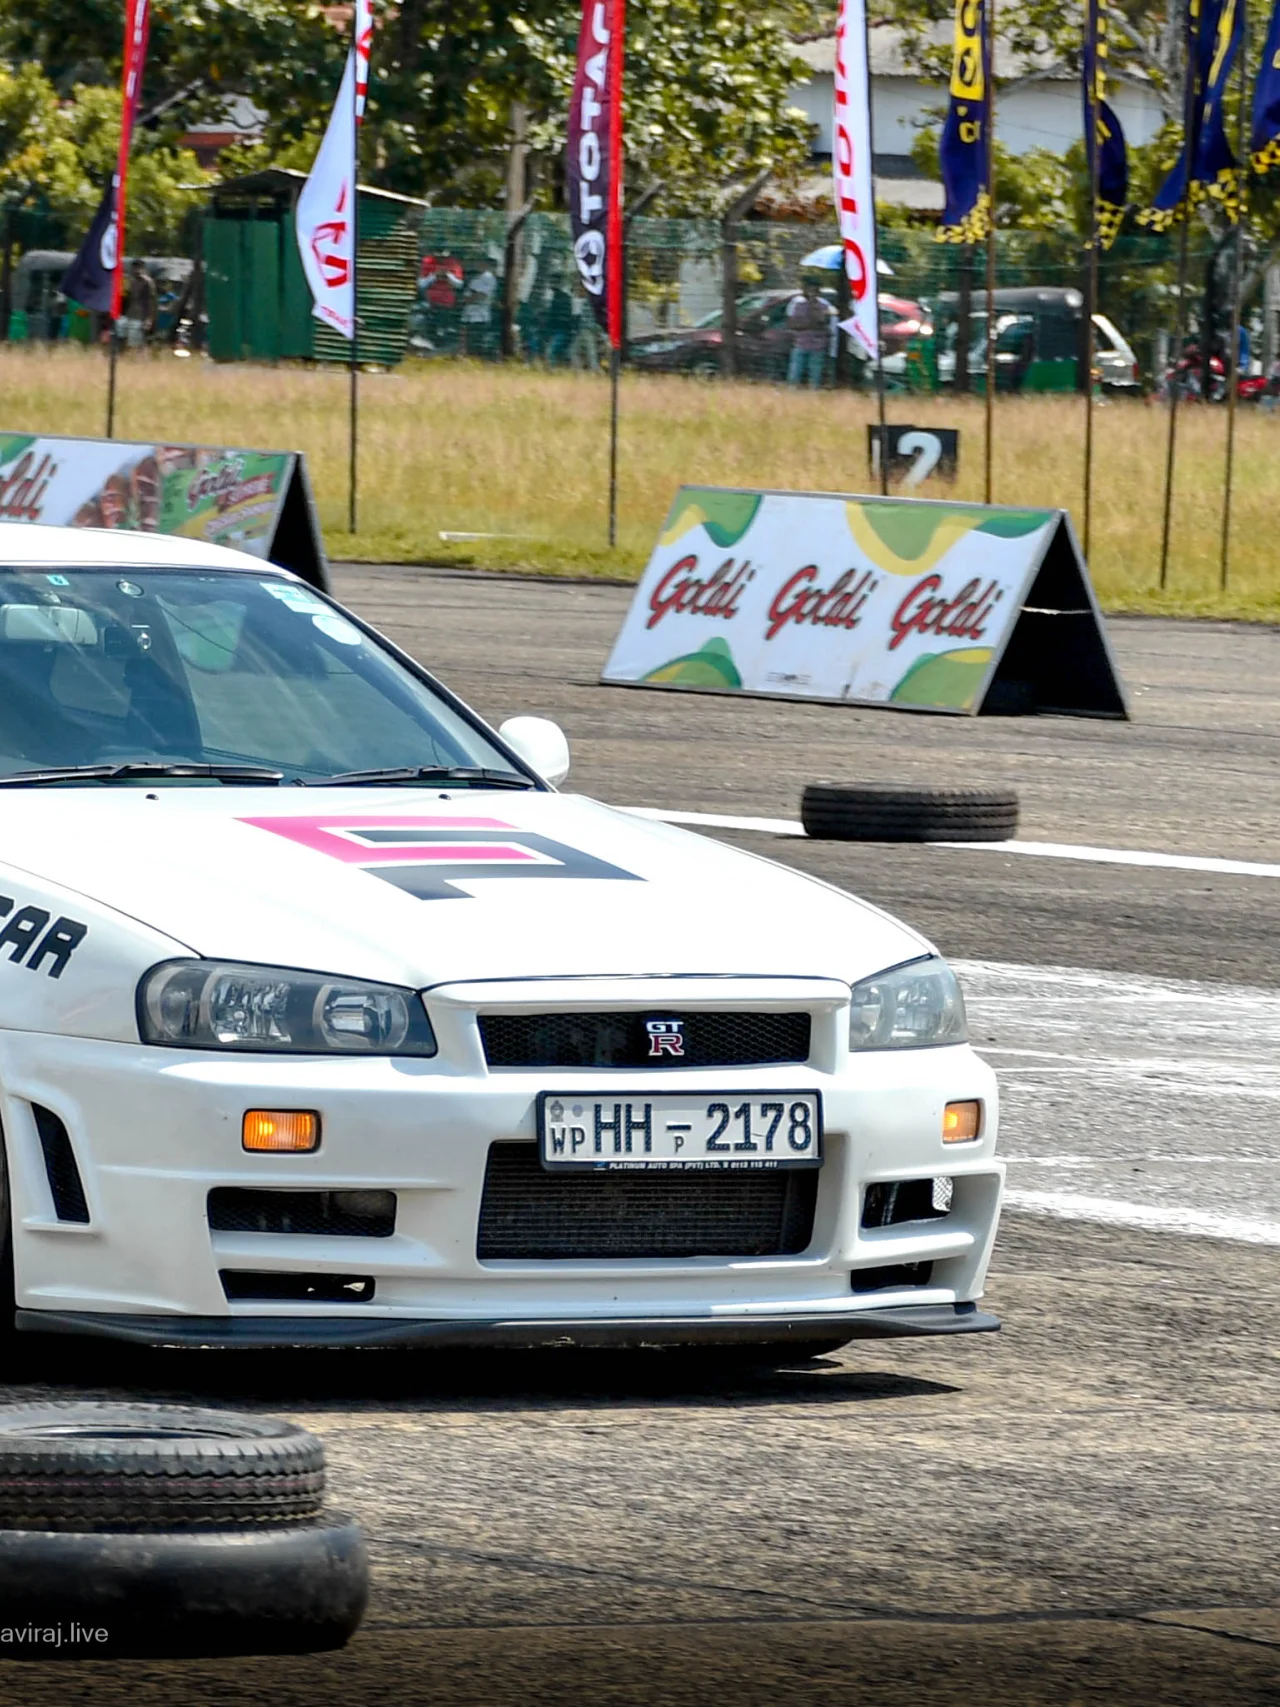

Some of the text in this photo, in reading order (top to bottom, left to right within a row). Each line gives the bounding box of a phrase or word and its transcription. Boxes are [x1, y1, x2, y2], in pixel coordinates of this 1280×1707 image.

[646, 554, 1004, 651] Goldi Goldi Goldi
[646, 1021, 684, 1033] GT
[648, 1033, 685, 1056] R
[593, 1102, 652, 1153] HH
[706, 1101, 811, 1153] 2178
[550, 1126, 586, 1155] WP
[609, 1162, 647, 1170] PLATINUM
[647, 1162, 668, 1170] AUTO
[669, 1161, 684, 1170] SPA
